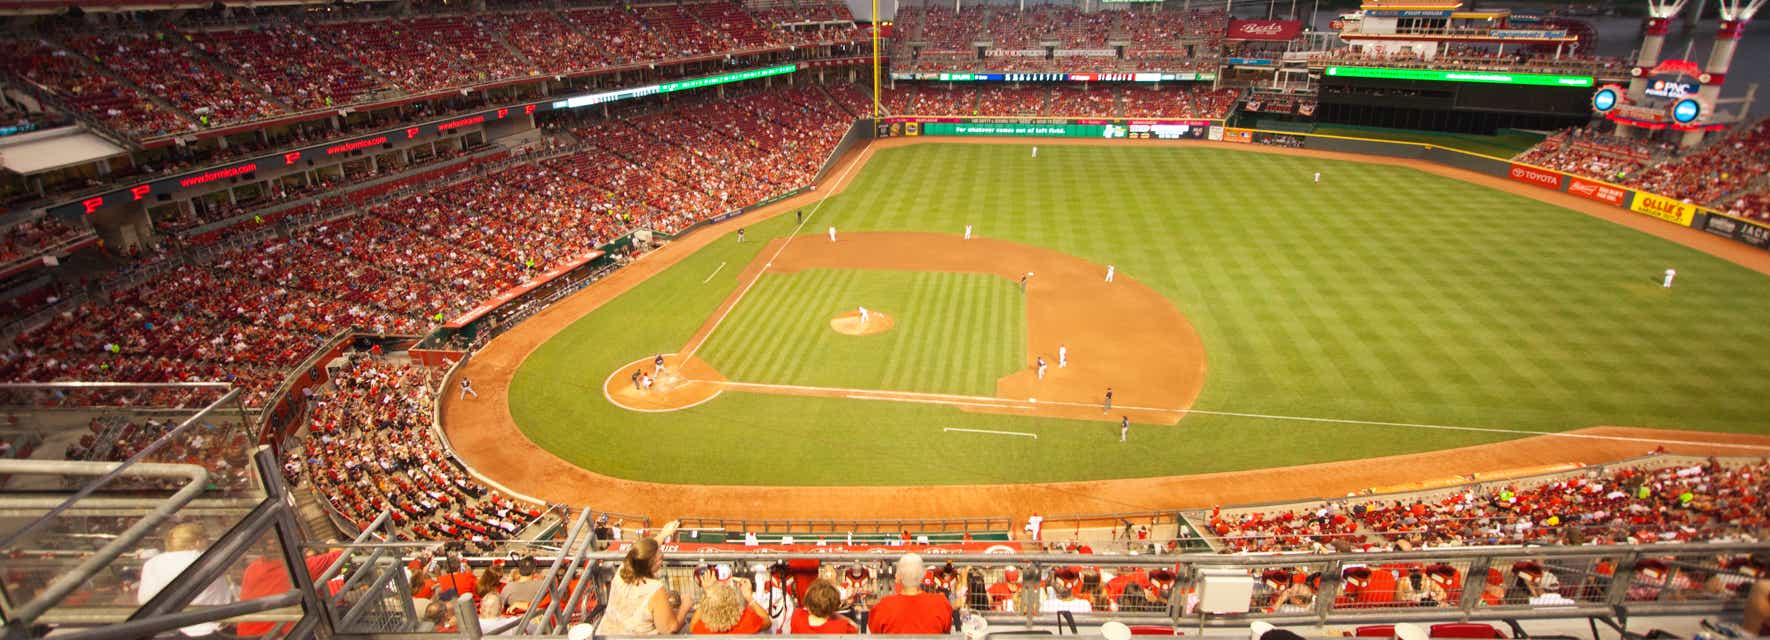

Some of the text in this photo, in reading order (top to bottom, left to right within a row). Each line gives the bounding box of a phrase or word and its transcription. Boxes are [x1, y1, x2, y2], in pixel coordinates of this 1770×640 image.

[1240, 23, 1282, 35] Reds
[1664, 82, 1690, 97] PNC
[180, 163, 257, 187] www.formica.com
[1526, 170, 1558, 185] TOYOTA
[1642, 197, 1685, 218] OLLIE'S
[1740, 223, 1769, 241] JACK
